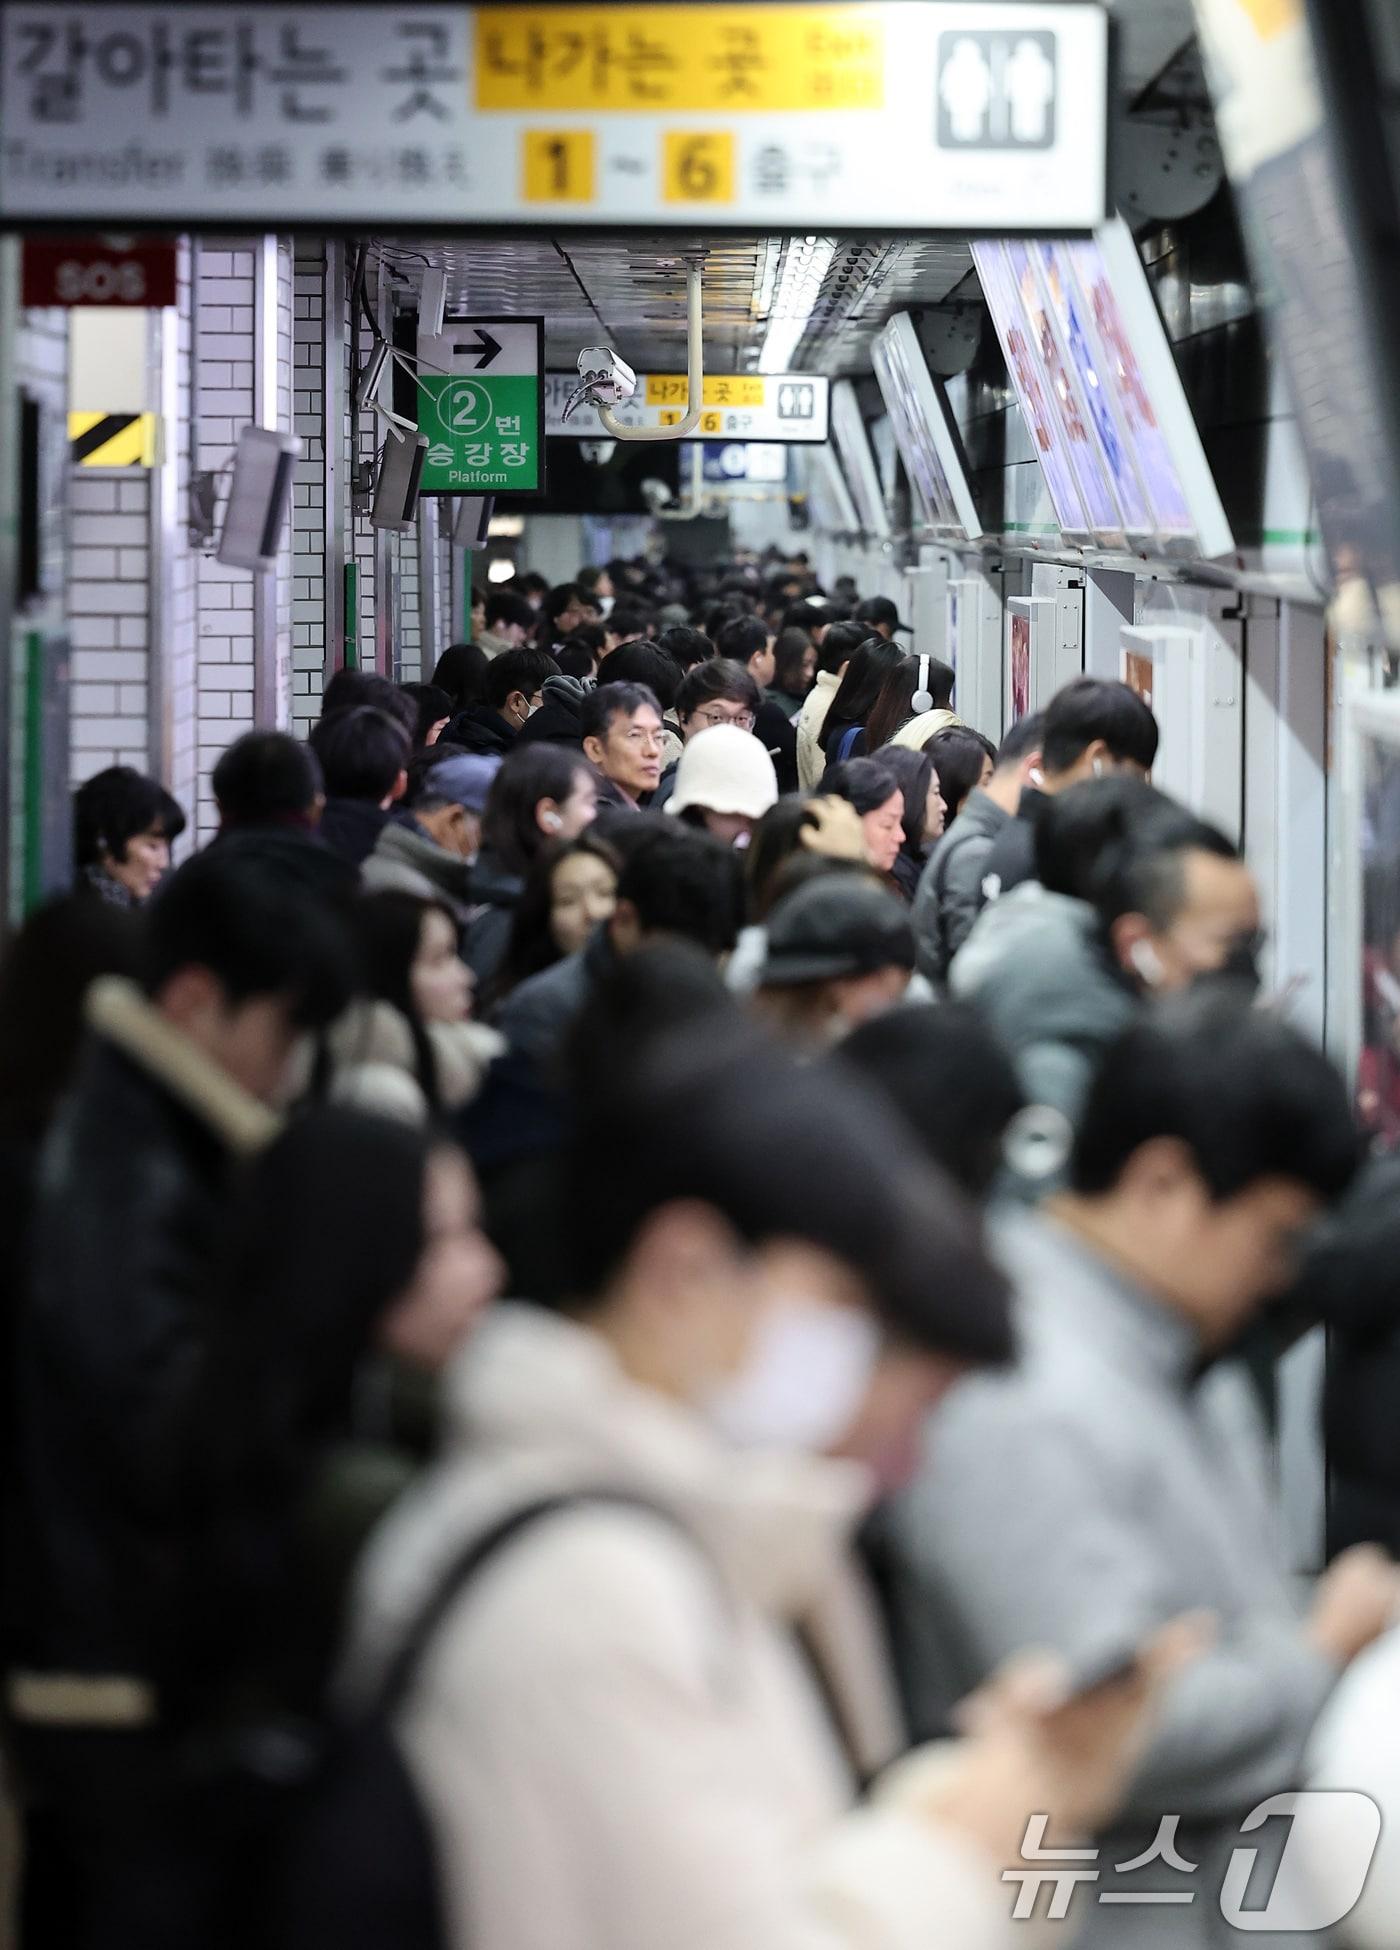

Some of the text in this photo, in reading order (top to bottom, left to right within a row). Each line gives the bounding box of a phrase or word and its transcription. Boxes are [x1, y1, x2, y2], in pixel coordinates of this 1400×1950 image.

[15, 19, 459, 123] 갈아타는 곳
[483, 22, 768, 99] 나가는 곳
[546, 135, 571, 193] 1
[677, 134, 716, 195] 6
[752, 140, 844, 198] 출구
[56, 260, 146, 301] SOS
[714, 383, 732, 402] 곳
[495, 415, 521, 436] 번
[704, 412, 717, 431] 6
[448, 470, 508, 483] Platform
